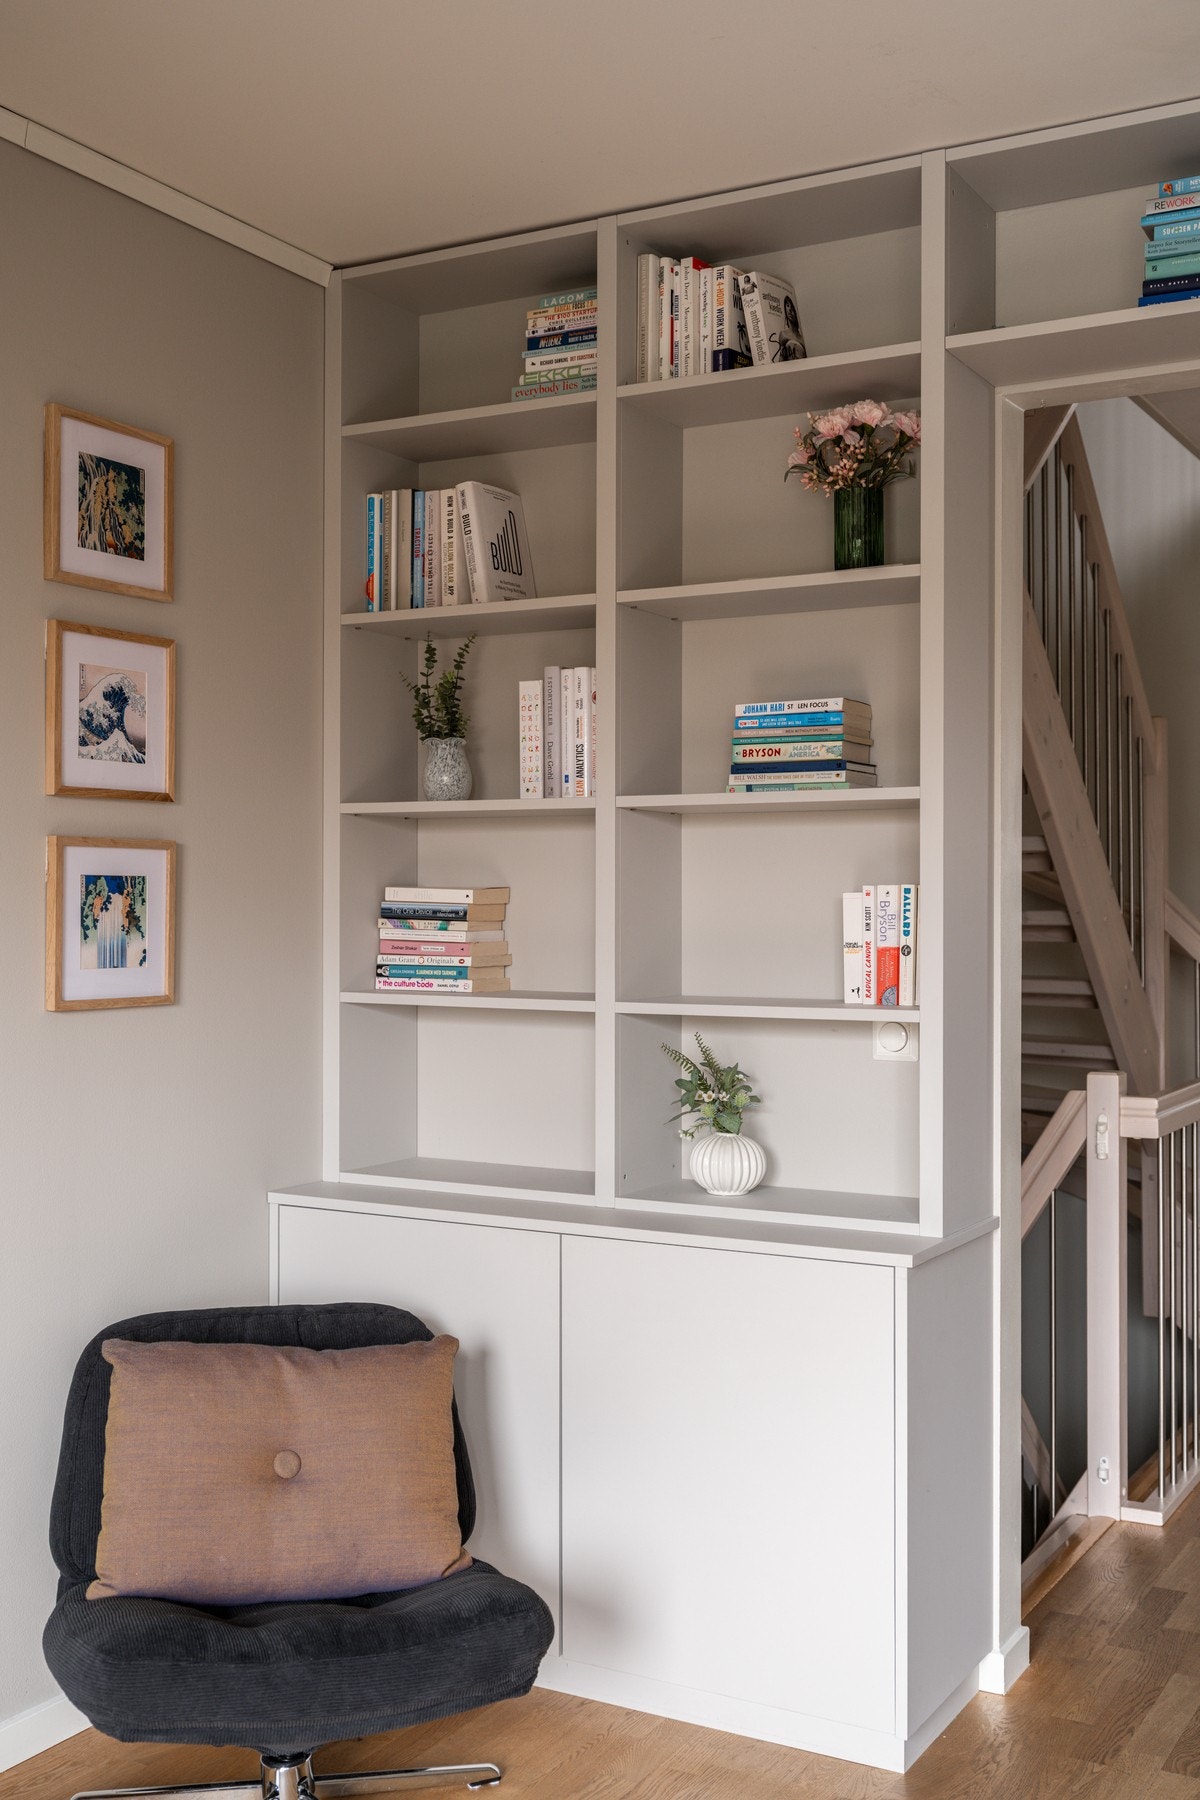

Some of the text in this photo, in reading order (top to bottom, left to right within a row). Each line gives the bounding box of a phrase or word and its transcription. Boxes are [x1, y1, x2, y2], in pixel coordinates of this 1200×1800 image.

[1154, 196, 1195, 210] REWORK
[544, 292, 585, 307] LAGOM
[572, 301, 586, 310] FOCUS
[716, 268, 724, 347] THE 4-HOUR WORK WEEK
[572, 307, 597, 317] STARTUP
[538, 334, 562, 348] INFLUENCE
[750, 310, 765, 362] anthony kiedis
[524, 365, 581, 384] EKKO
[515, 380, 578, 398] everybody lies
[462, 513, 472, 536] BUILD
[490, 510, 522, 576] BUILD
[743, 704, 768, 714] JOHANN
[770, 703, 785, 712] HARI
[742, 748, 781, 758] BRYSON
[788, 750, 820, 758] AMERICA
[576, 744, 584, 779] ANALYTICS
[576, 780, 584, 796] LEAN
[903, 888, 911, 937] BALLARD
[877, 900, 890, 942] Bryson
[888, 914, 896, 930] Bill
